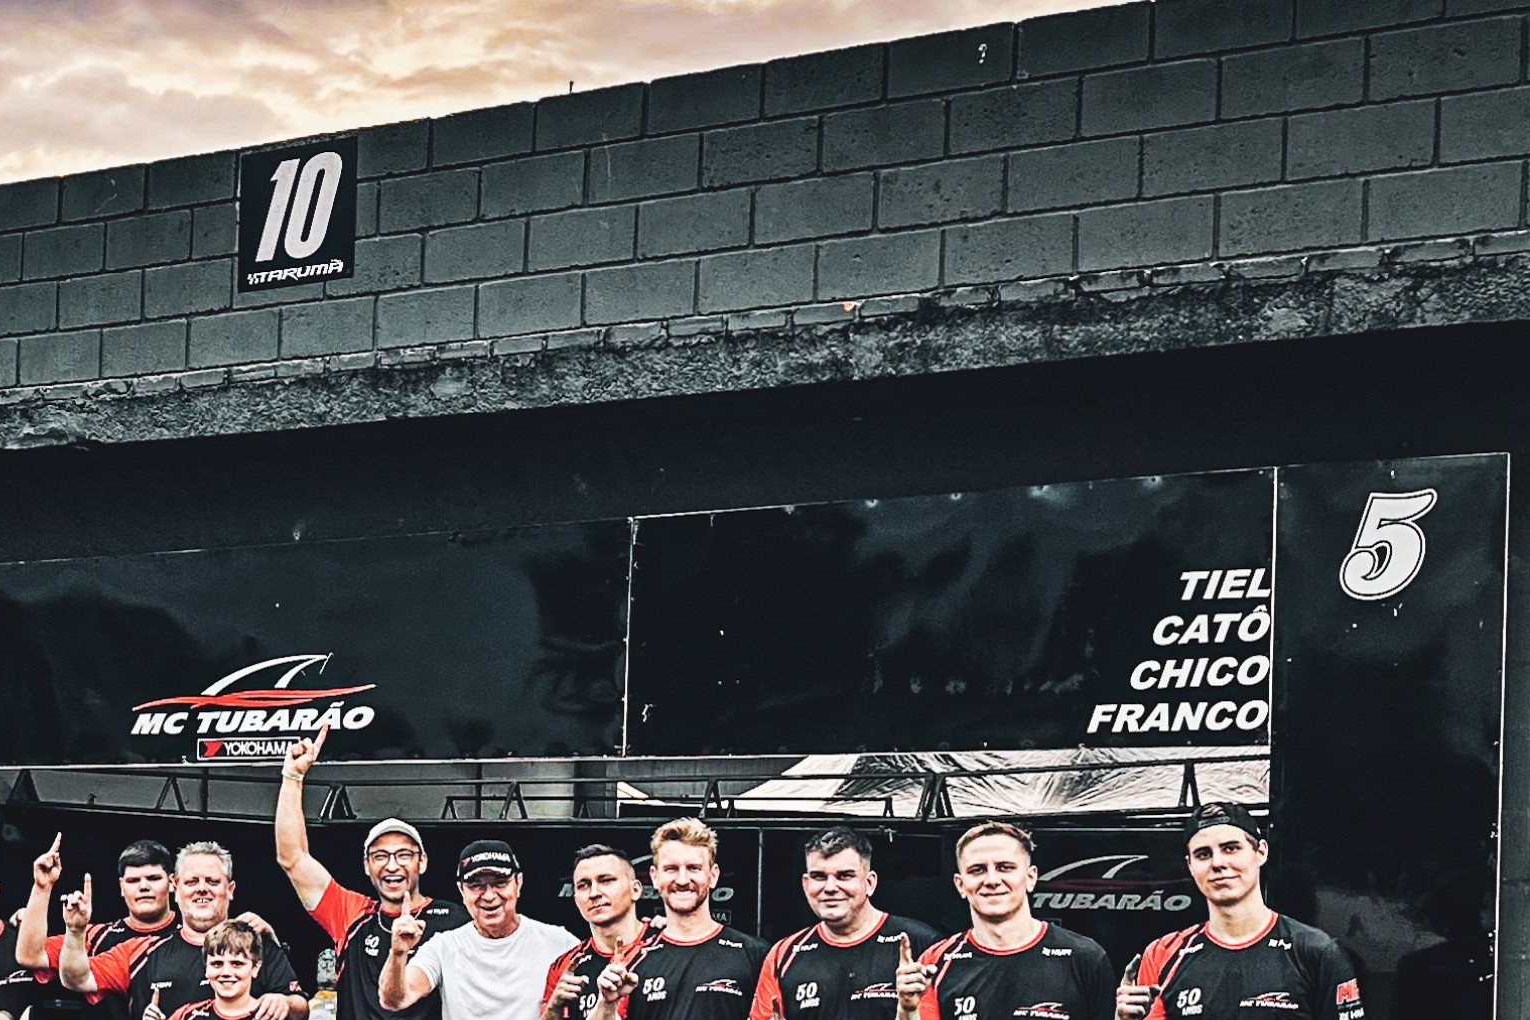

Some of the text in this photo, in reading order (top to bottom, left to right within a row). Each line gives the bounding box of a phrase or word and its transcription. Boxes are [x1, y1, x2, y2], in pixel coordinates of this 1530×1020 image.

[255, 152, 343, 262] 10
[1340, 488, 1438, 600] 5
[1180, 568, 1271, 601] TIEL
[1152, 604, 1271, 646] CATÔ
[1129, 655, 1270, 690] CHICO
[131, 701, 375, 735] MC TUBARÃO
[1086, 700, 1269, 733] FRANCO
[1033, 889, 1192, 912] TUBARÃO
[579, 993, 597, 1010] 50
[643, 976, 666, 994] 50
[795, 981, 818, 1000] 50
[1176, 987, 1202, 1008] 50
[954, 995, 976, 1016] 50
